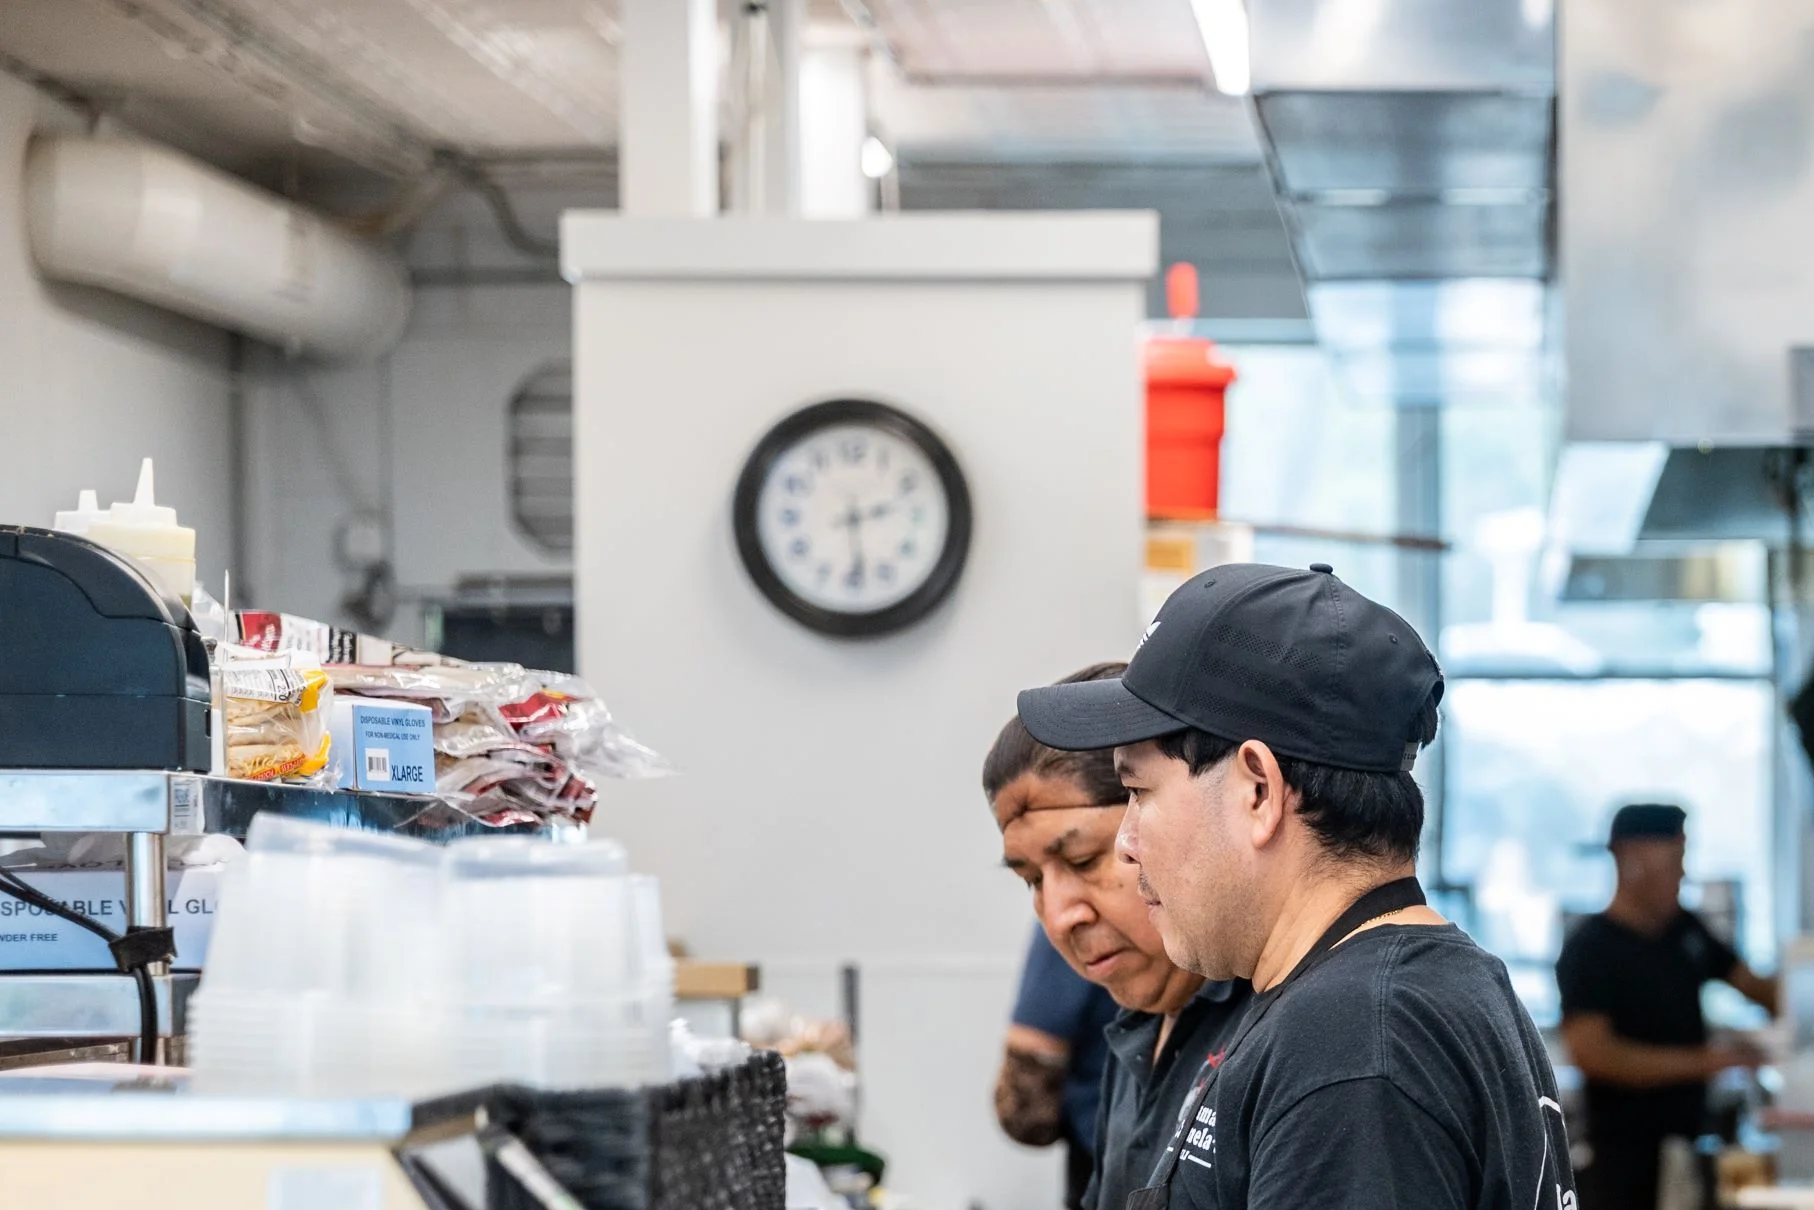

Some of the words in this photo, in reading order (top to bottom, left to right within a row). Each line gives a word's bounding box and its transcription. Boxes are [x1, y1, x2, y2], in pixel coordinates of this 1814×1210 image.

[360, 716, 390, 725] DISPOSABLE
[391, 718, 404, 726] VINYL
[405, 719, 425, 727] GLOVES
[391, 764, 423, 782] XLARGE
[30, 933, 58, 942] FREE
